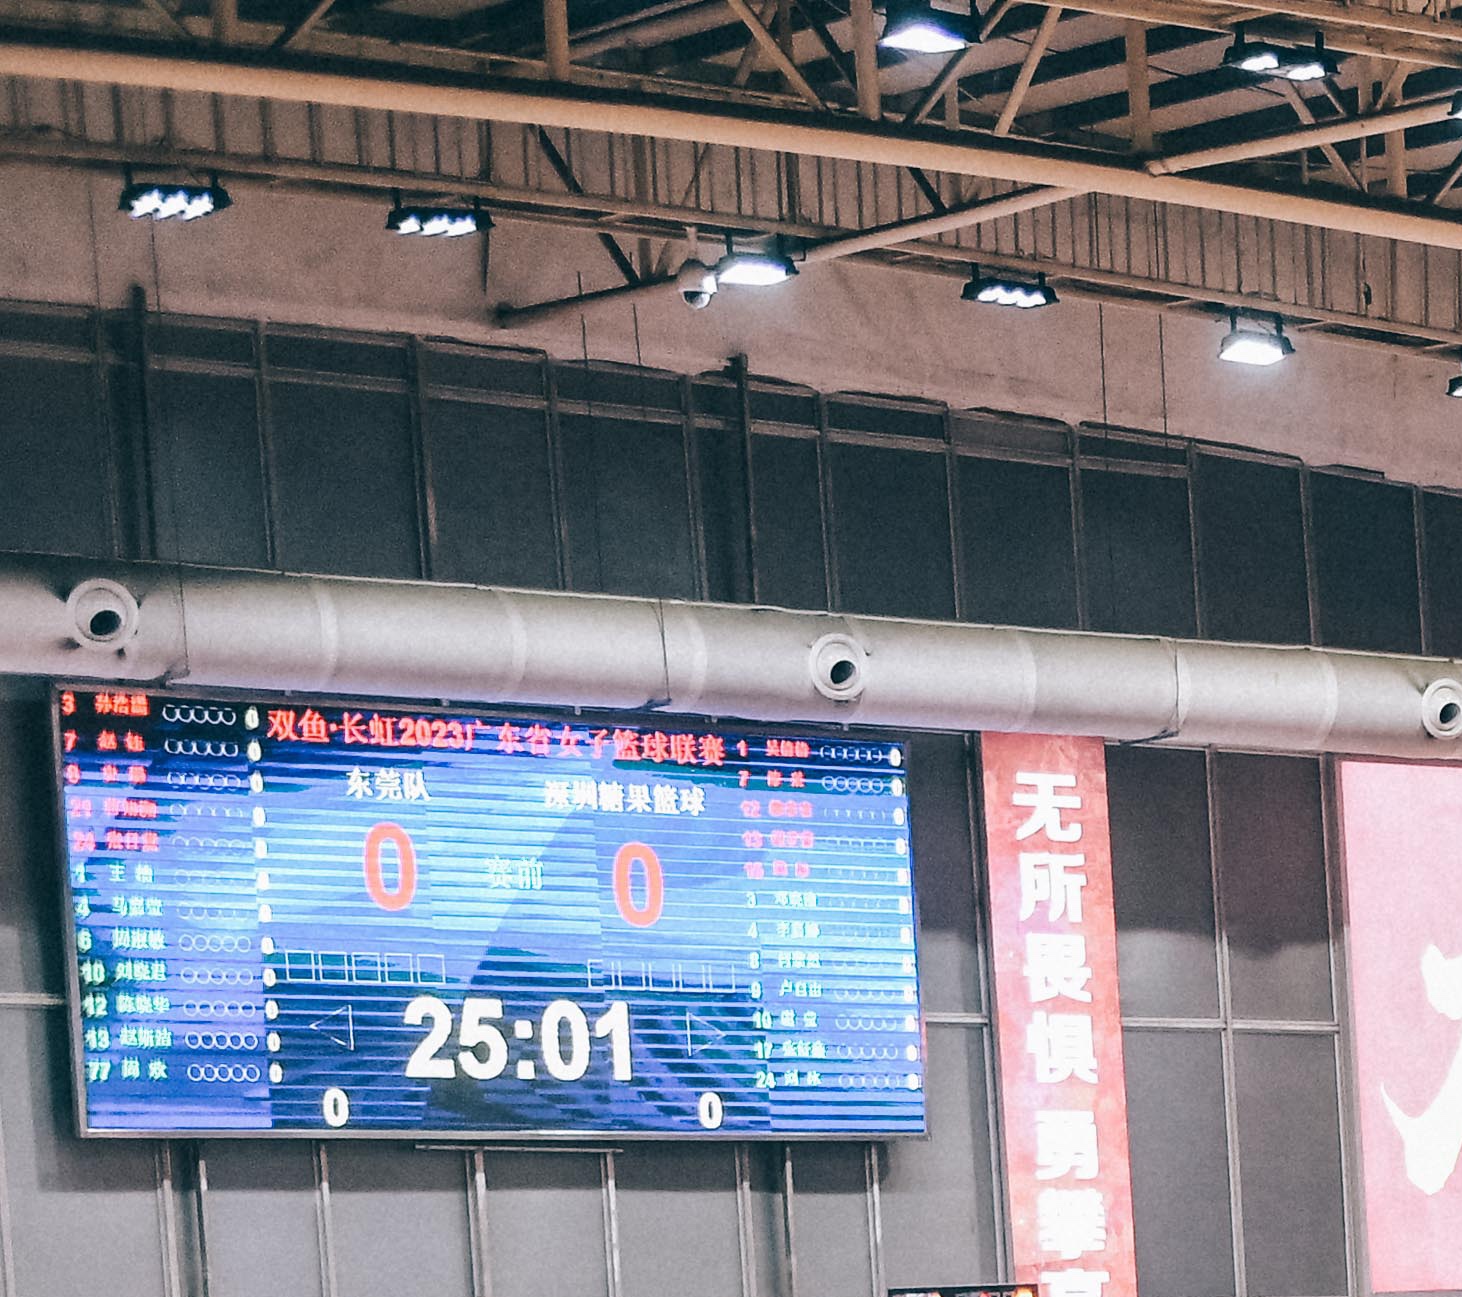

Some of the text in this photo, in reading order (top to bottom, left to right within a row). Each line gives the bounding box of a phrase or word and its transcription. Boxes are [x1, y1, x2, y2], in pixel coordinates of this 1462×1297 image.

[267, 709, 726, 766] 双鱼·长虹2023广东省女子篮球联赛
[345, 766, 431, 803] 东莞队
[544, 780, 706, 817] 深圳糖果篮球
[364, 823, 417, 912] 0
[613, 843, 664, 927] 0
[405, 998, 633, 1083] 25:01
[324, 1089, 349, 1128] 0
[699, 1091, 723, 1130] 0
